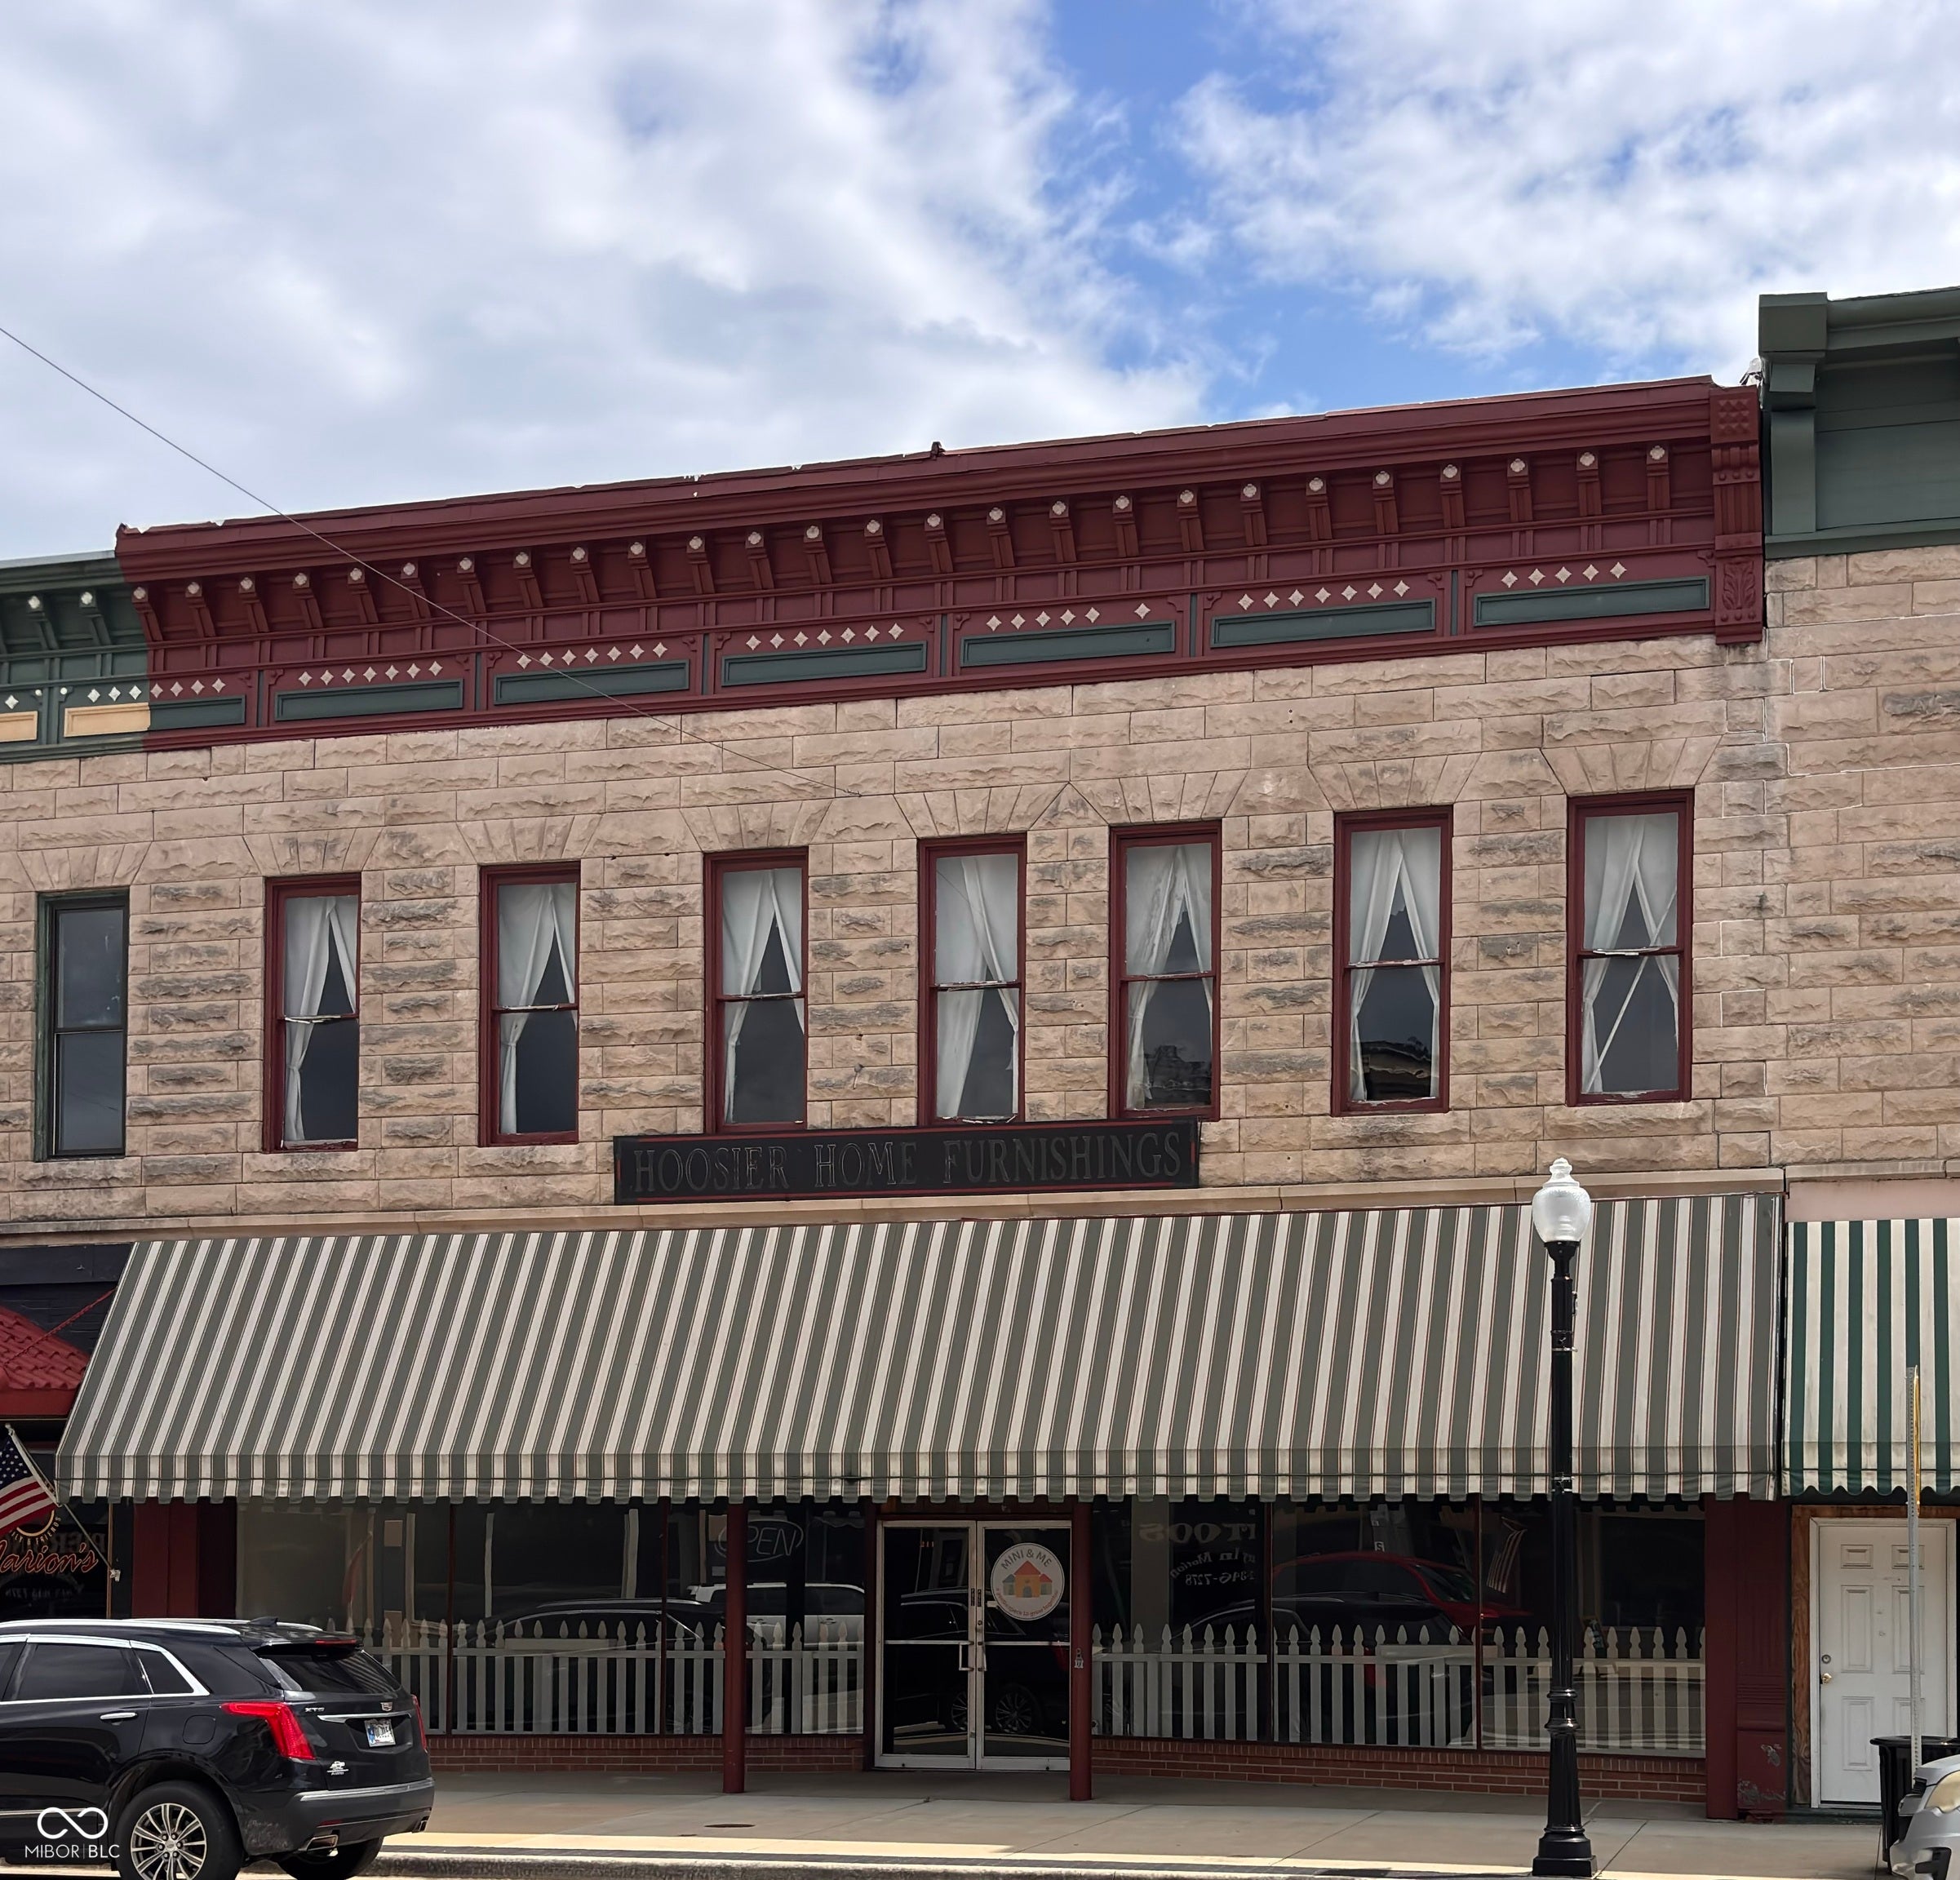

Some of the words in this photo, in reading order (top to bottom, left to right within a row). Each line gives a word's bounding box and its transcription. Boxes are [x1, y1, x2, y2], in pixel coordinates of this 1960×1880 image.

[633, 1145, 791, 1192] HOOSIER
[814, 1141, 919, 1187] HOME
[942, 1131, 1182, 1184] FURNISHINGS
[1000, 1549, 1024, 1570] MINI
[1026, 1548, 1035, 1559] &
[1036, 1551, 1053, 1567] ME
